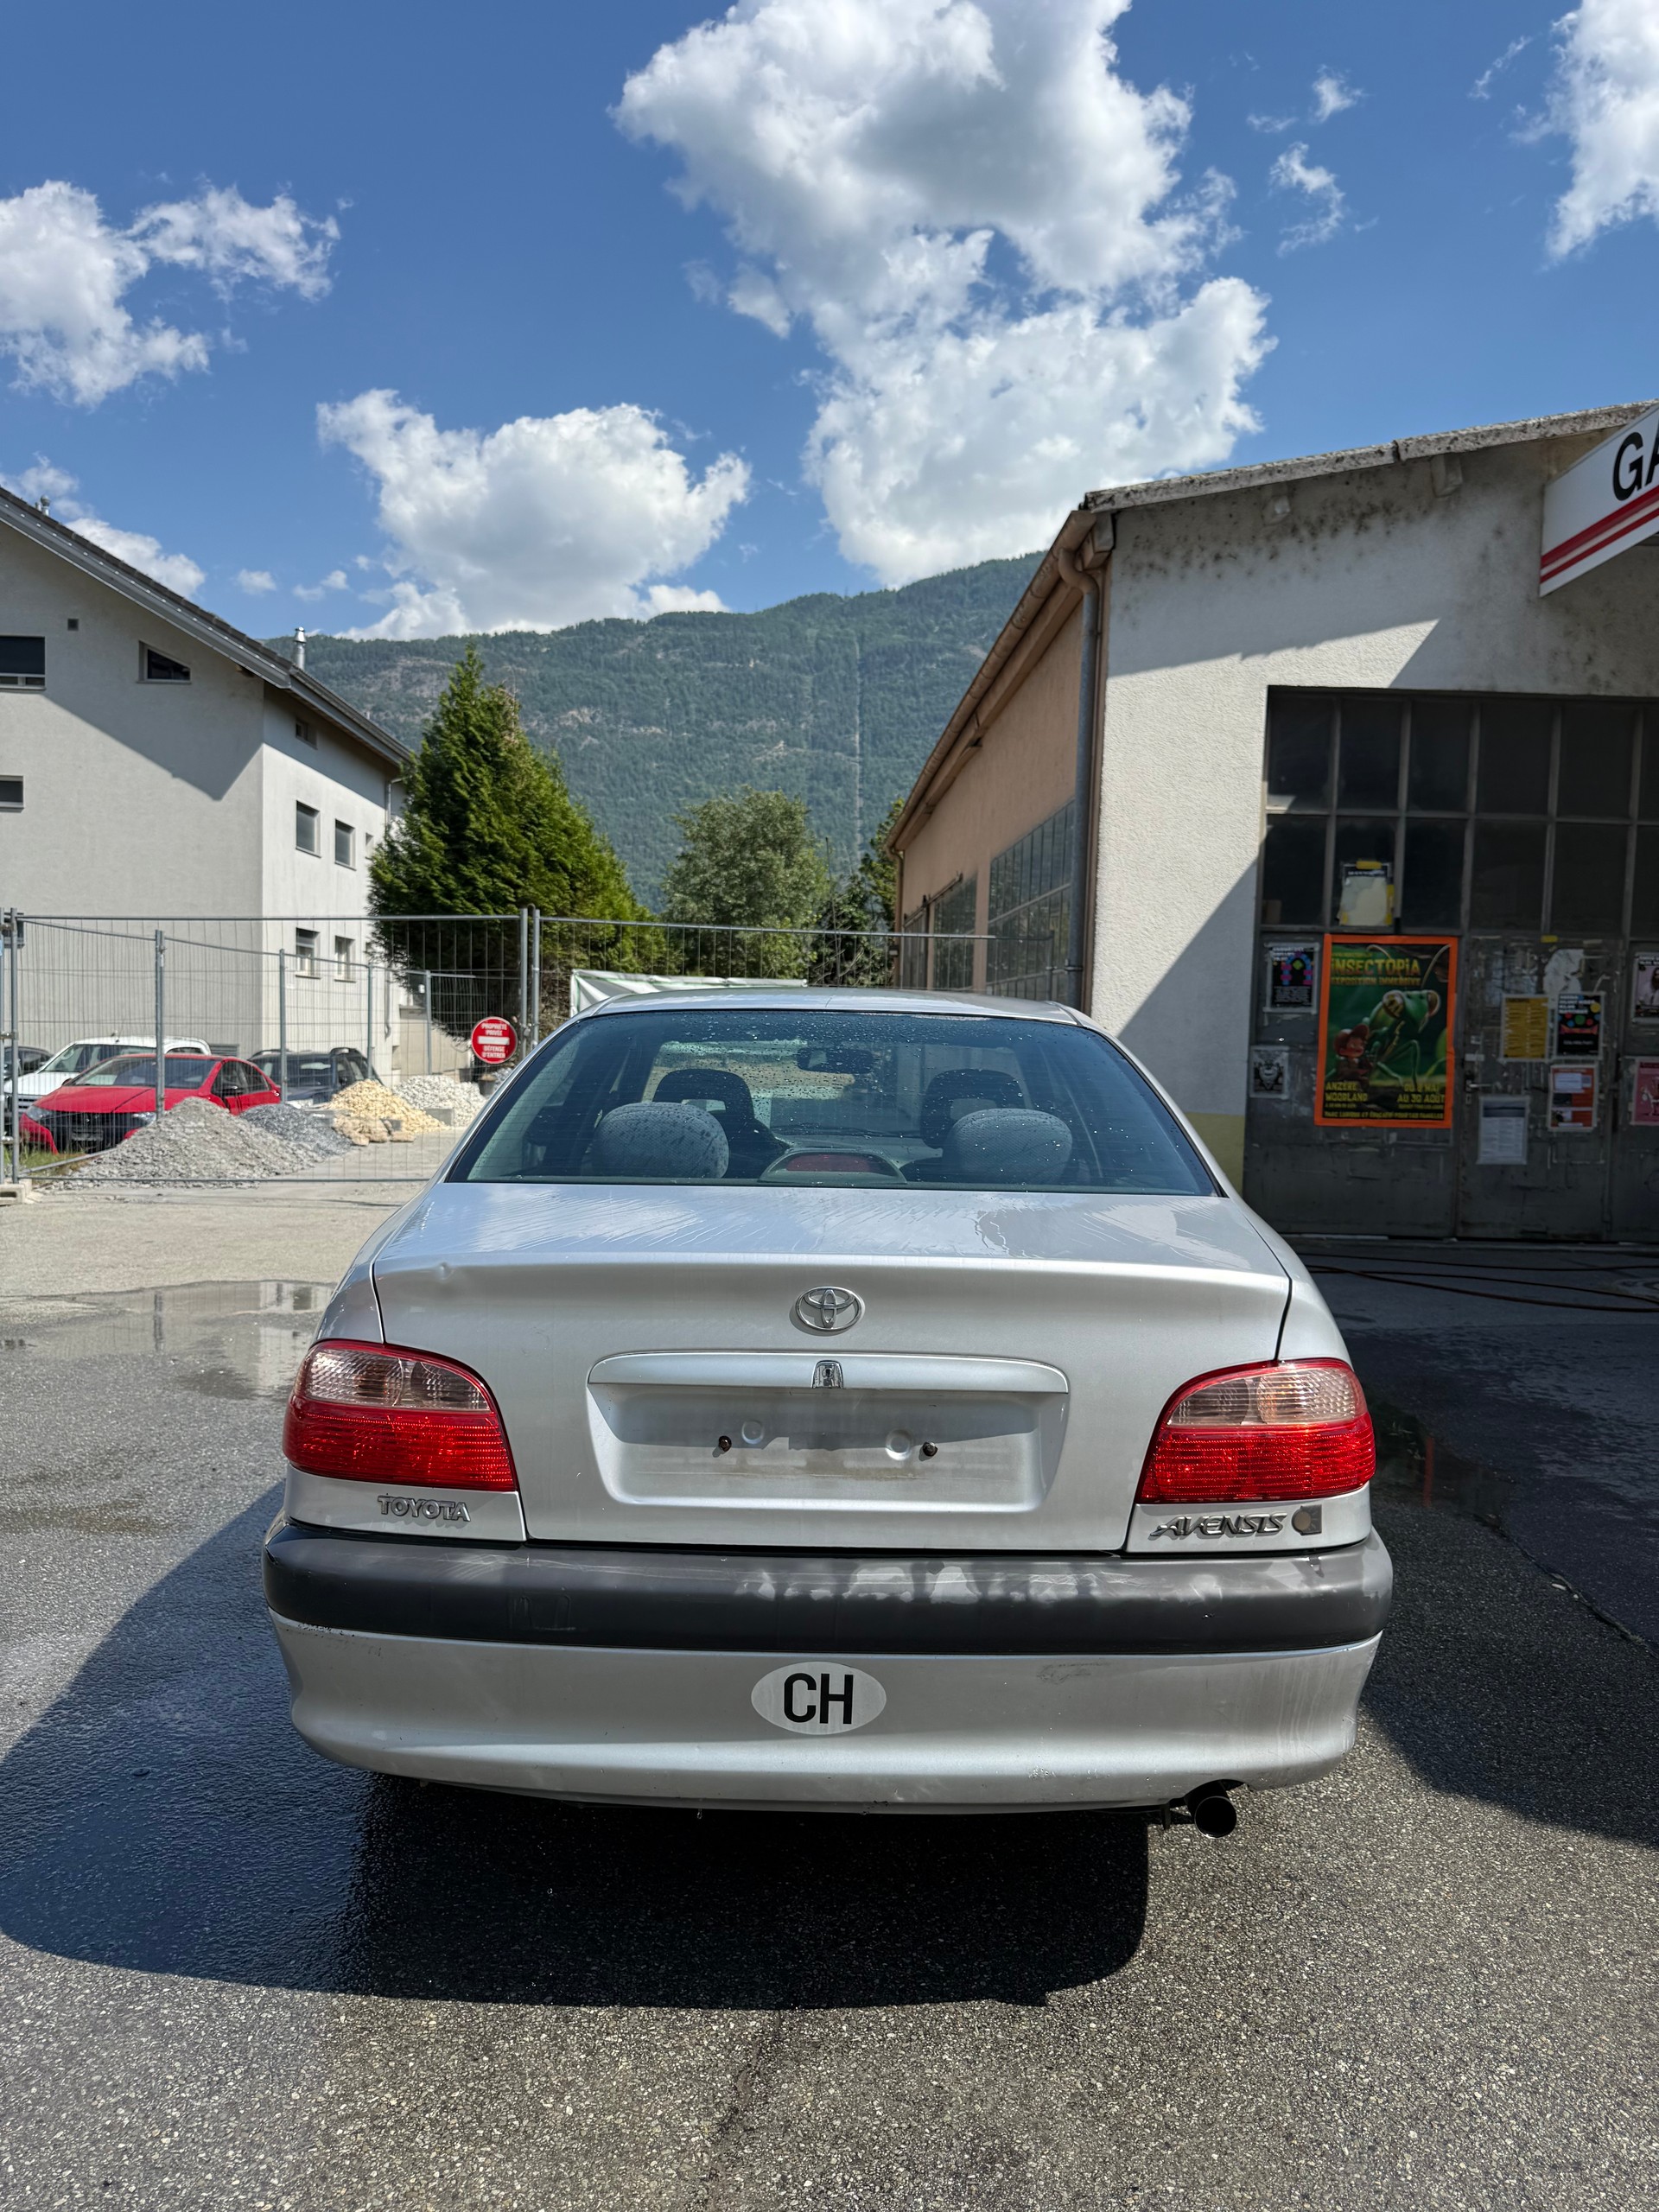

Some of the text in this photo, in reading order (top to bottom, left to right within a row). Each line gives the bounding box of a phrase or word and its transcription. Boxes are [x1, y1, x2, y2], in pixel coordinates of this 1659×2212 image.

[378, 1495, 471, 1522] TOYOTA
[1149, 1512, 1287, 1536] AVENSIS
[784, 1673, 854, 1725] CH
